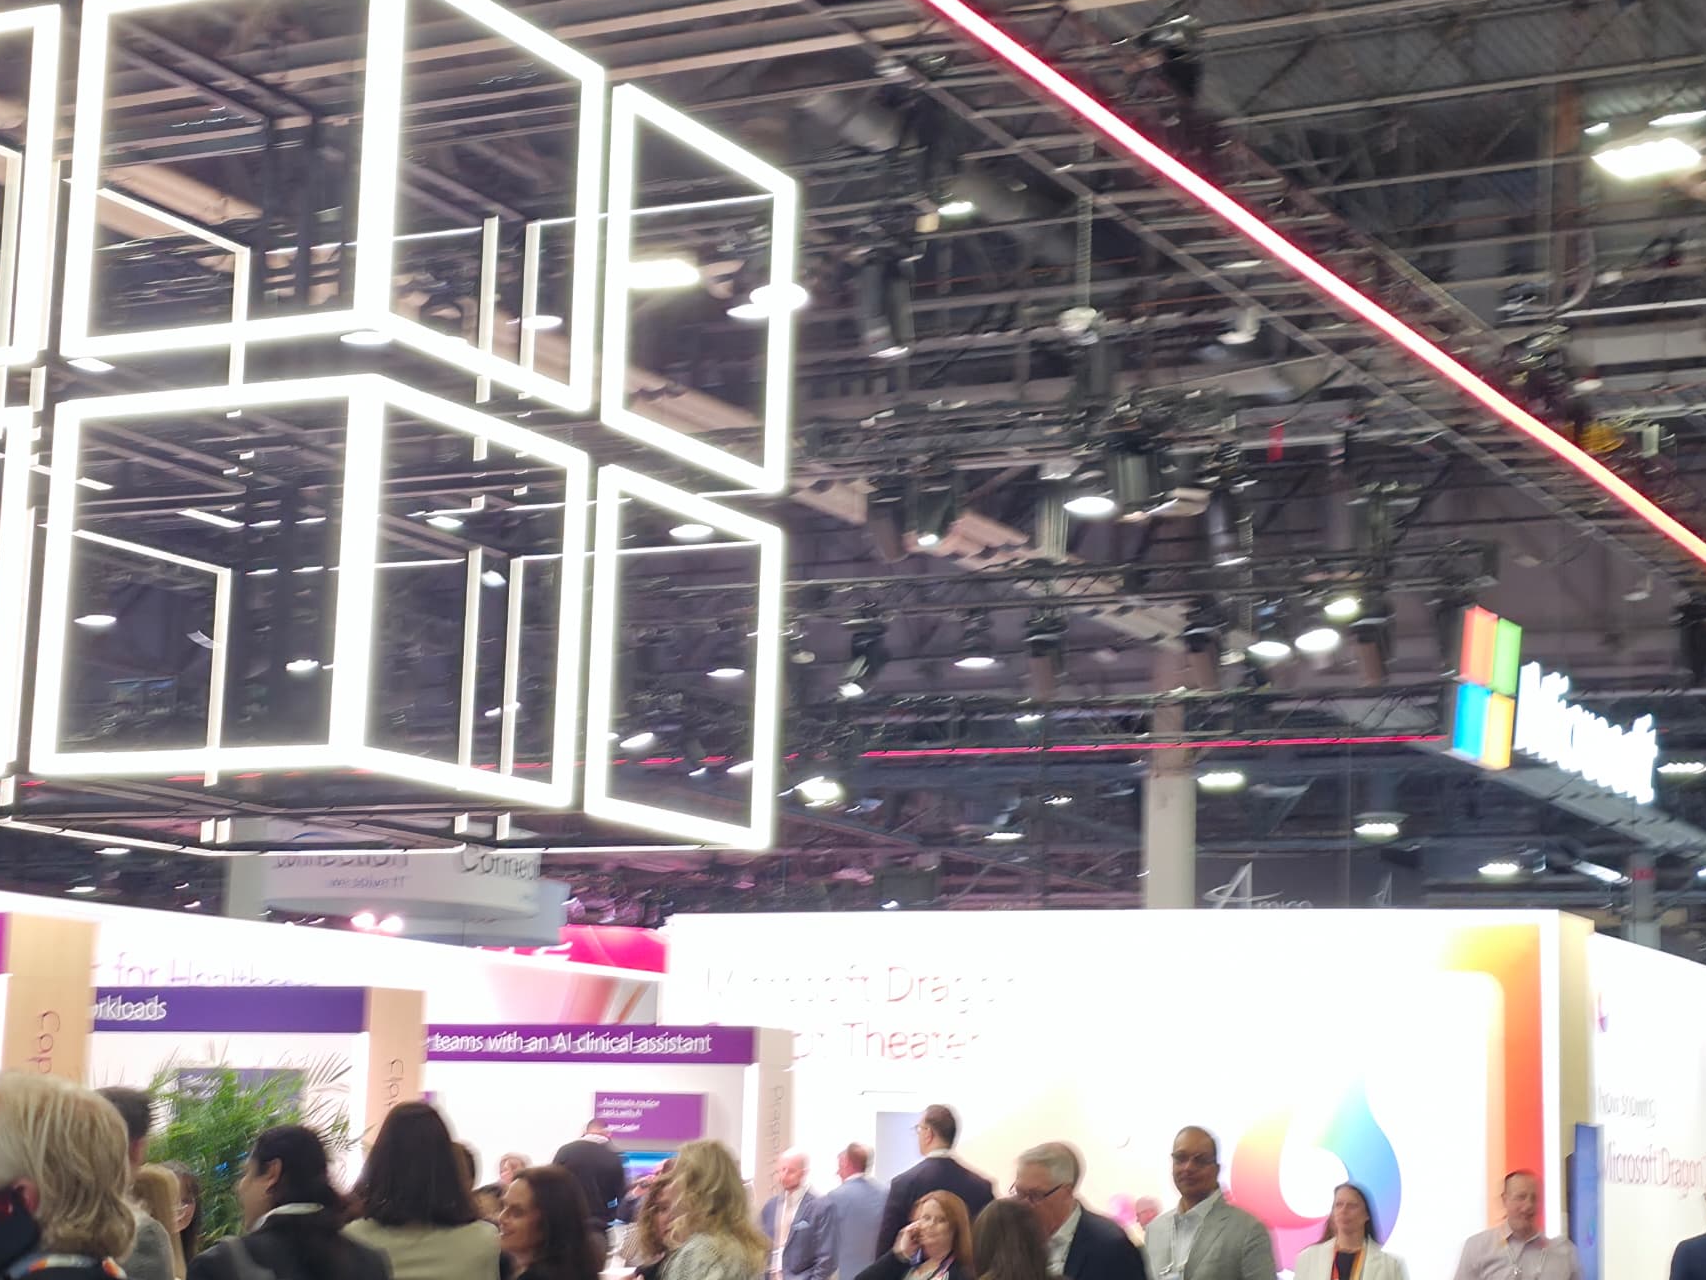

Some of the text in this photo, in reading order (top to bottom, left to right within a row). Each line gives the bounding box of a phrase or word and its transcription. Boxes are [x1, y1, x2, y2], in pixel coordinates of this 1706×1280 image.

[433, 1031, 484, 1053] teams
[487, 1029, 524, 1053] with
[575, 1030, 631, 1053] clinical
[635, 1031, 712, 1054] assistant
